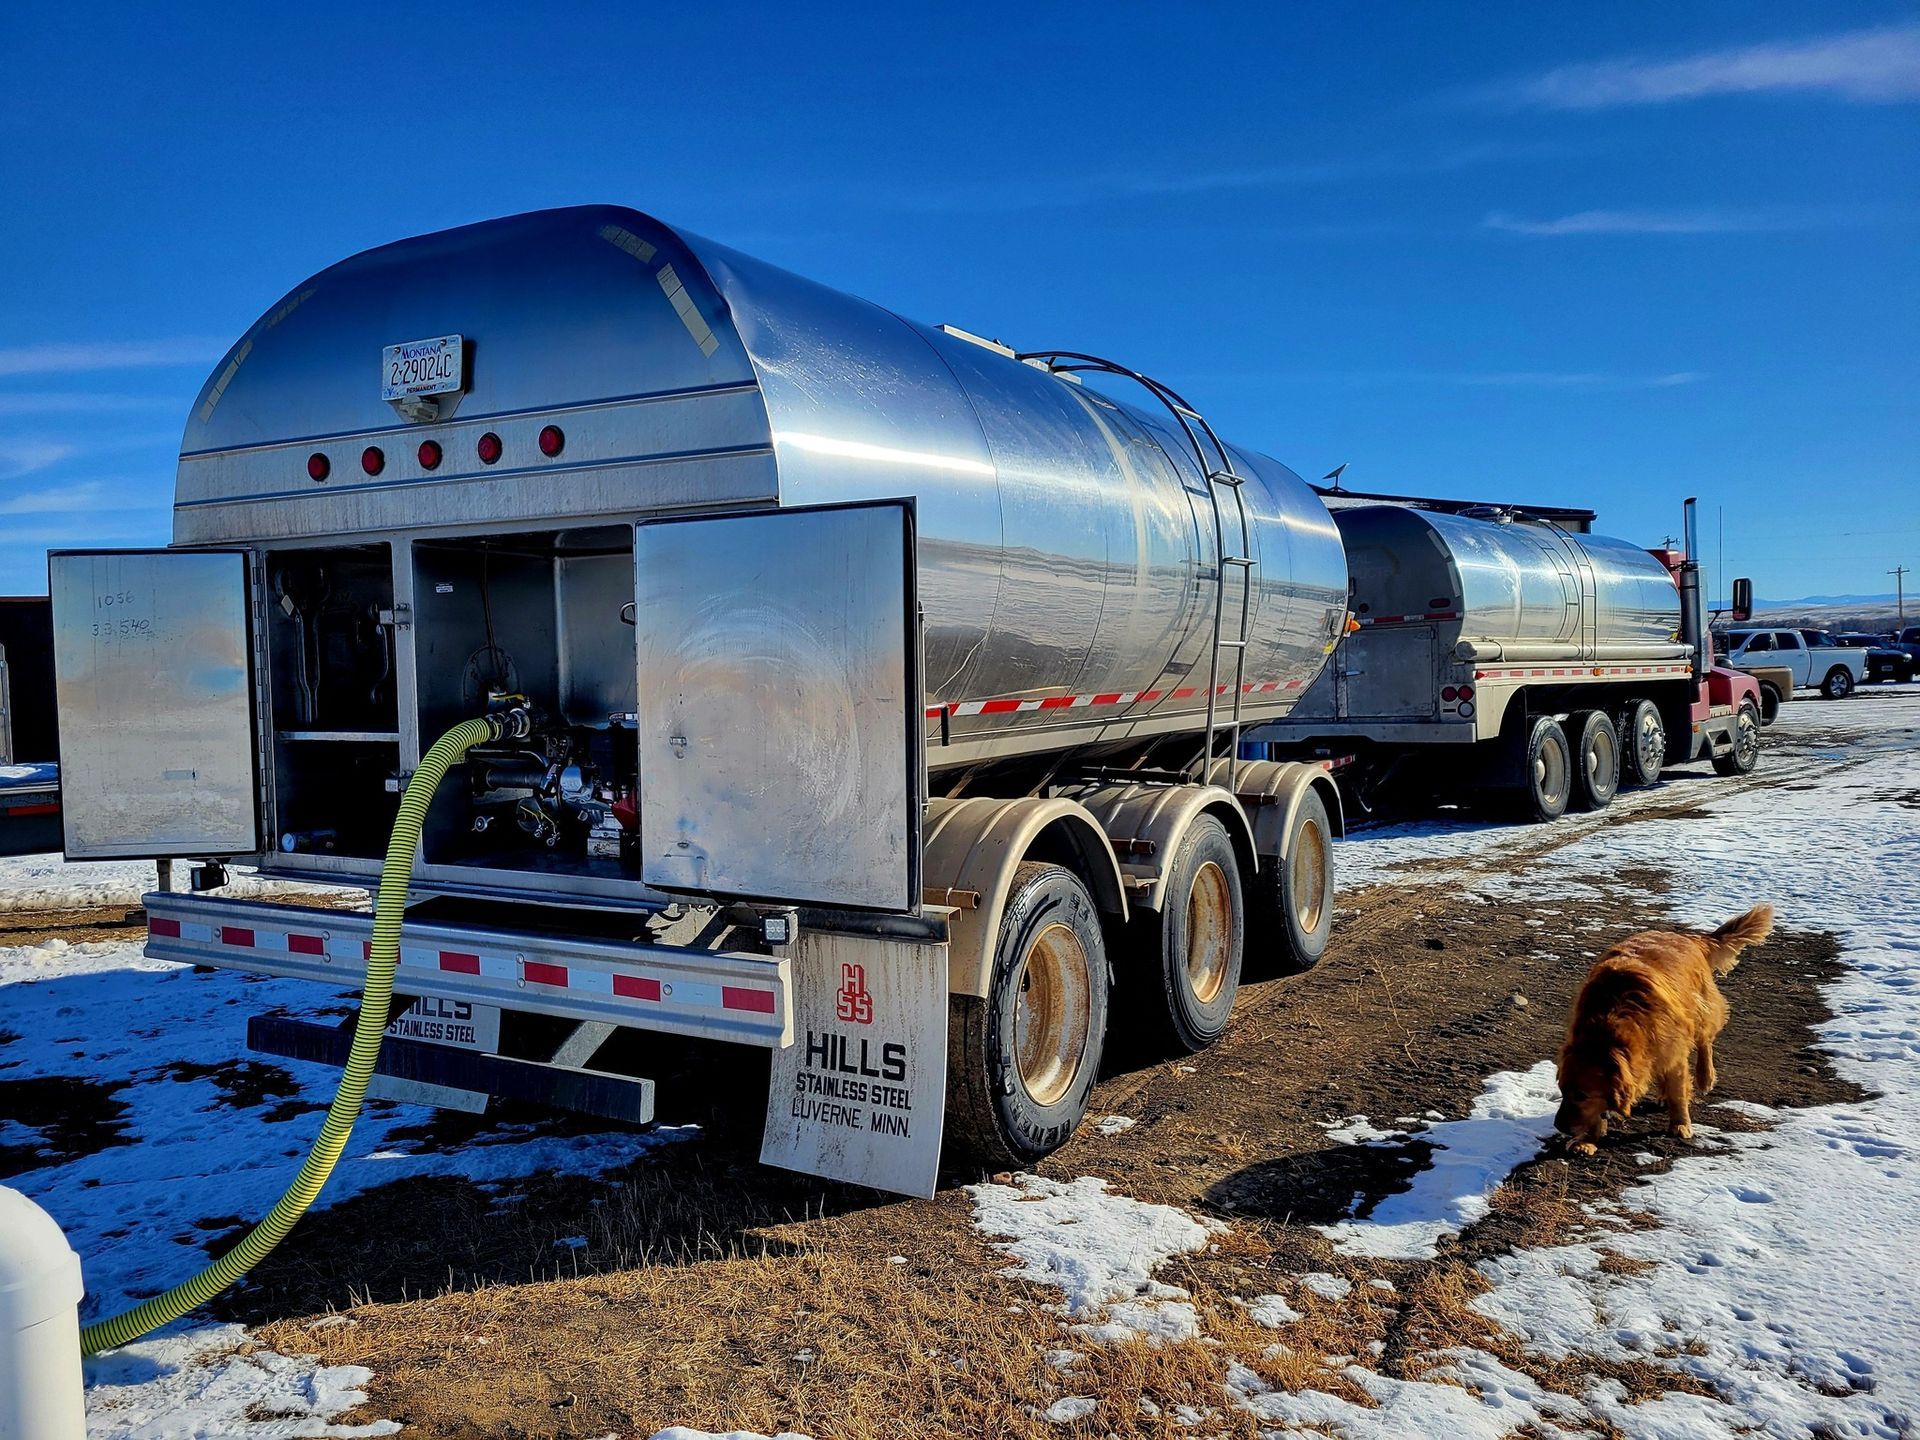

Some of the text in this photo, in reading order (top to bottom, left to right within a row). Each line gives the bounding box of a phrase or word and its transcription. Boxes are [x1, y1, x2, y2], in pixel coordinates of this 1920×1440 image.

[402, 345, 441, 359] MONTANA
[406, 384, 437, 394] PERMANENT
[409, 996, 472, 1021] ILLS
[389, 1019, 476, 1044] STAINLESS STEEL
[805, 1031, 906, 1082] HILLS
[796, 1071, 912, 1111] STAINLESS STEEL
[791, 1098, 911, 1139] LUVERNE, MINN.
